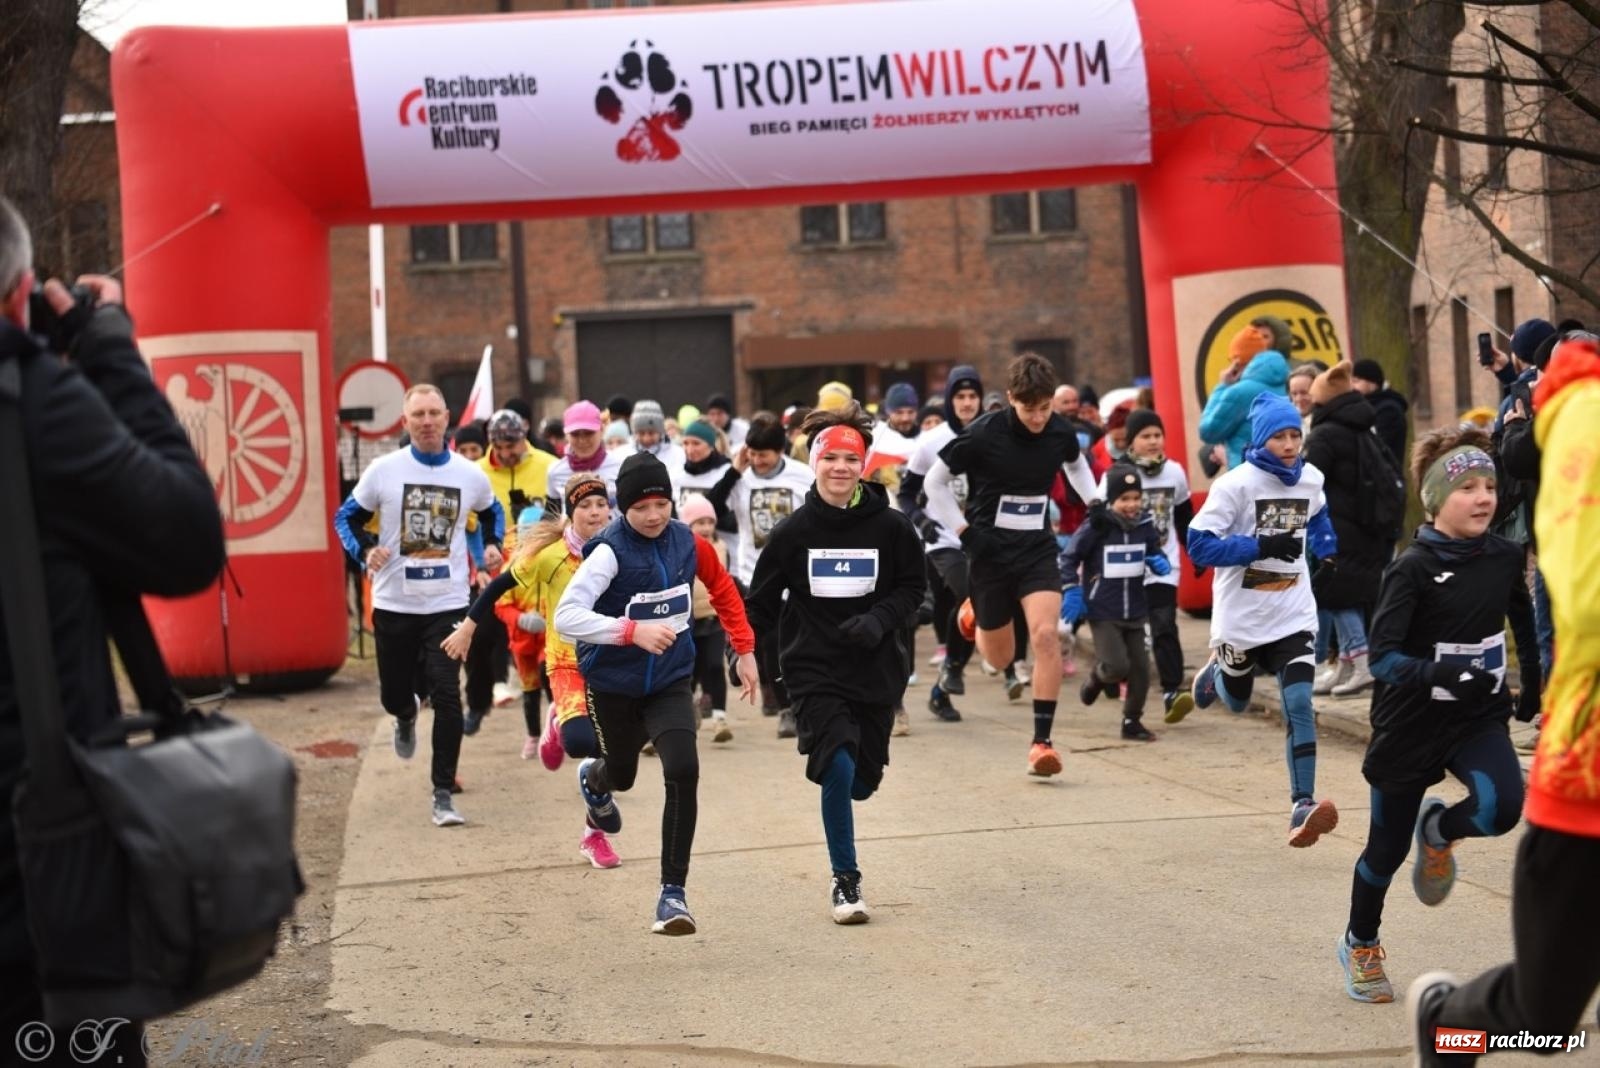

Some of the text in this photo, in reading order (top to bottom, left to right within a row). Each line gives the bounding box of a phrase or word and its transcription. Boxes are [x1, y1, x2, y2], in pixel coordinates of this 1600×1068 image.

[424, 73, 537, 99] Raciborskie
[749, 103, 1080, 136] BIEG PAMIĘCI ŻOŁNIERZY WYKLĘTYCH
[431, 125, 499, 151] Kultury
[1018, 504, 1030, 513] 47
[422, 568, 435, 578] 39
[834, 561, 851, 573] 44
[653, 603, 670, 614] 40
